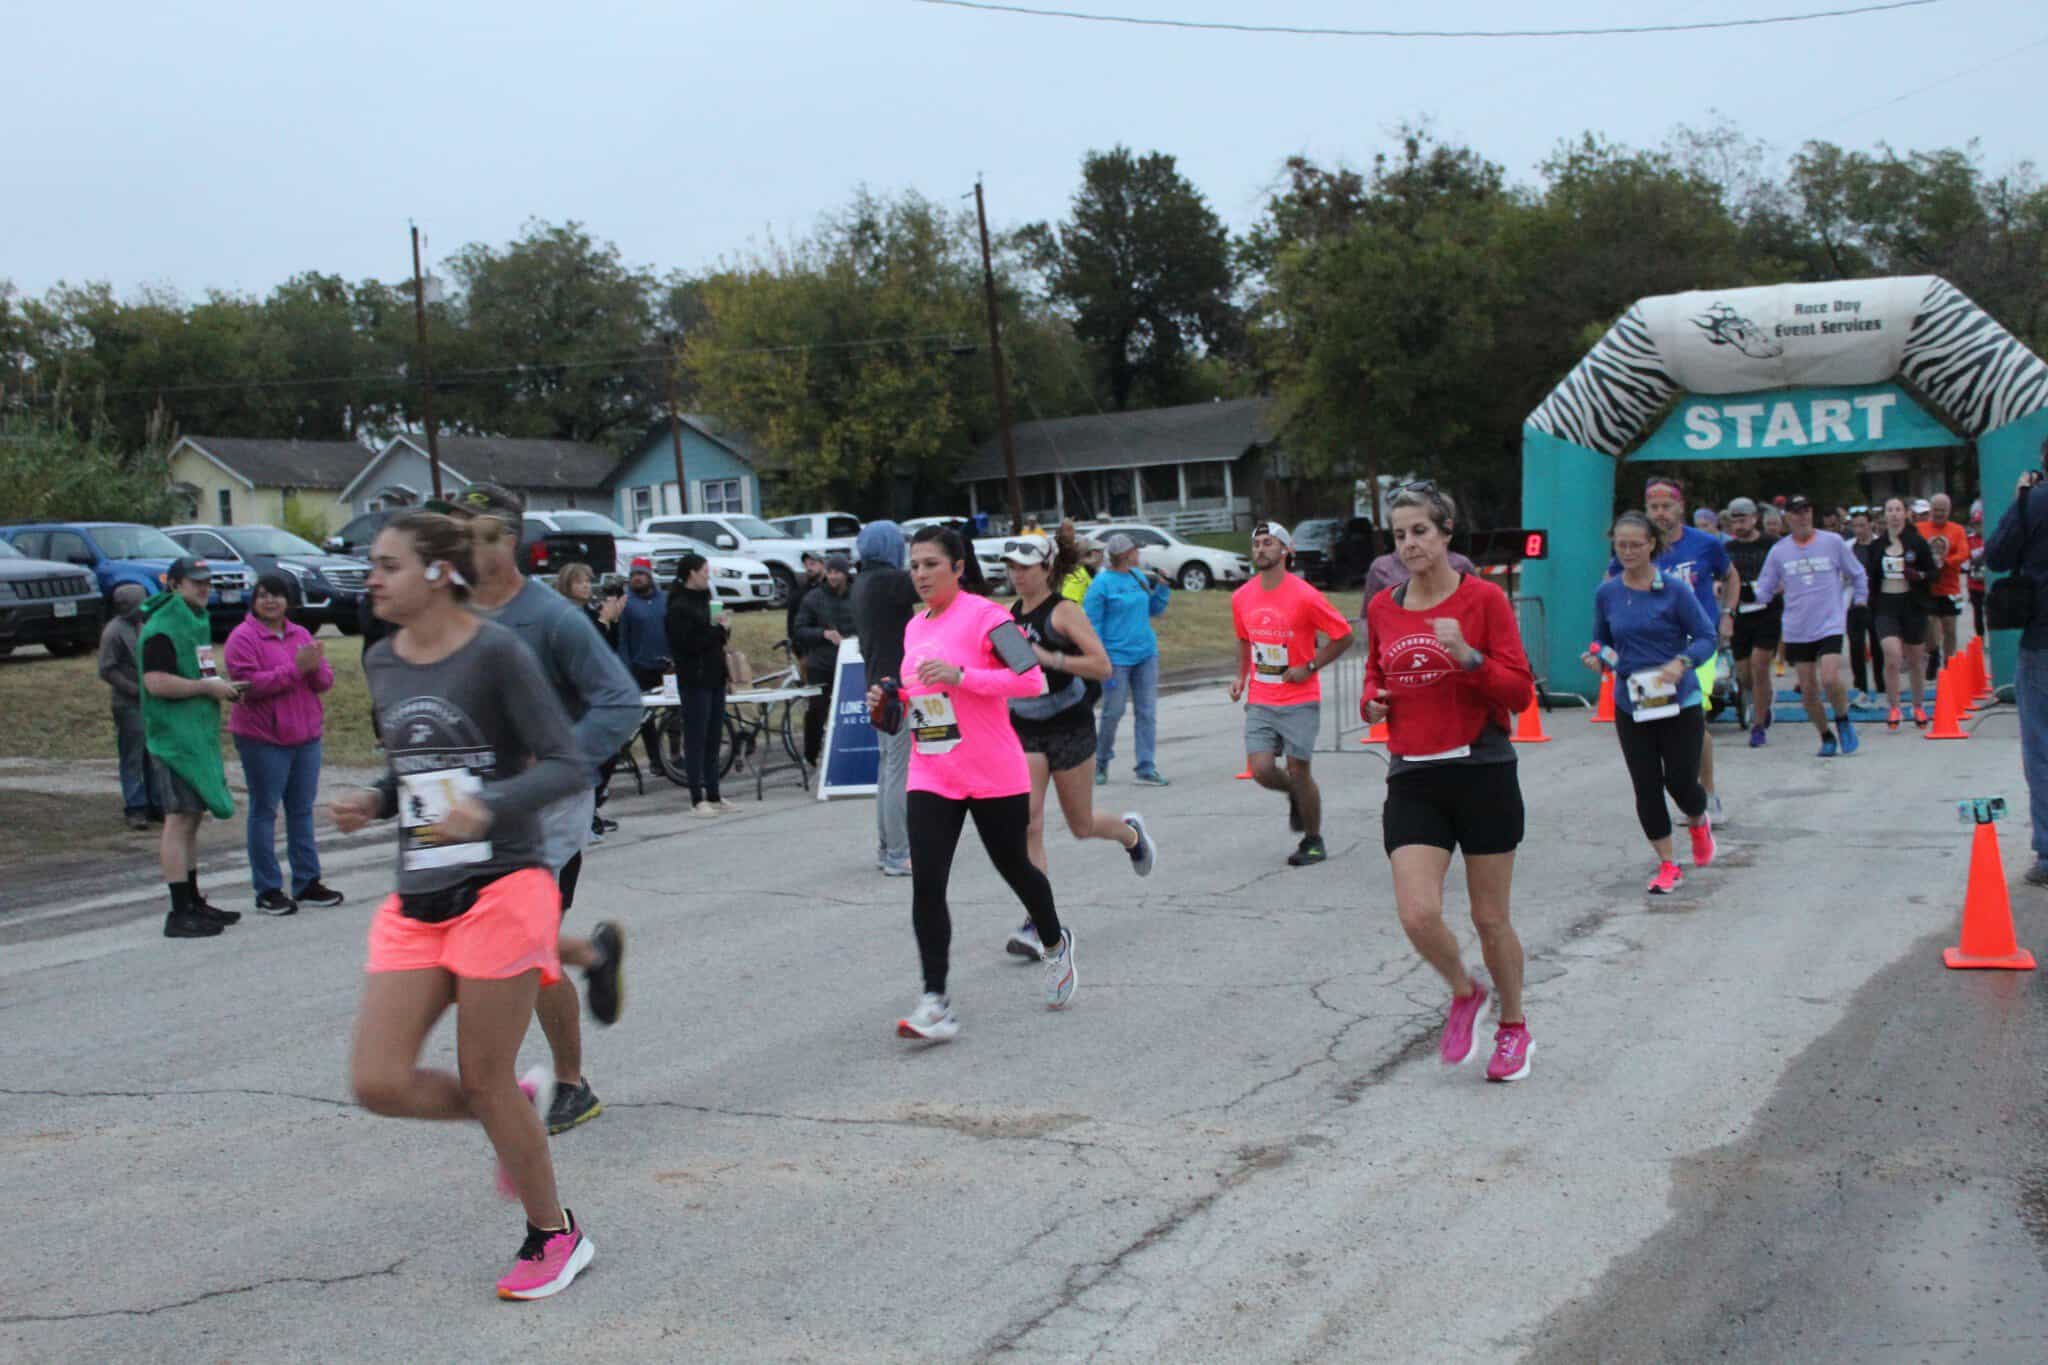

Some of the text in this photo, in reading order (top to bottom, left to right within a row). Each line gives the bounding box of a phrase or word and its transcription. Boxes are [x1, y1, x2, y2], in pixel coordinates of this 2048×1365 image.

[1794, 299, 1861, 315] Race Day
[1775, 318, 1881, 337] Event Services
[1684, 393, 1897, 450] START
